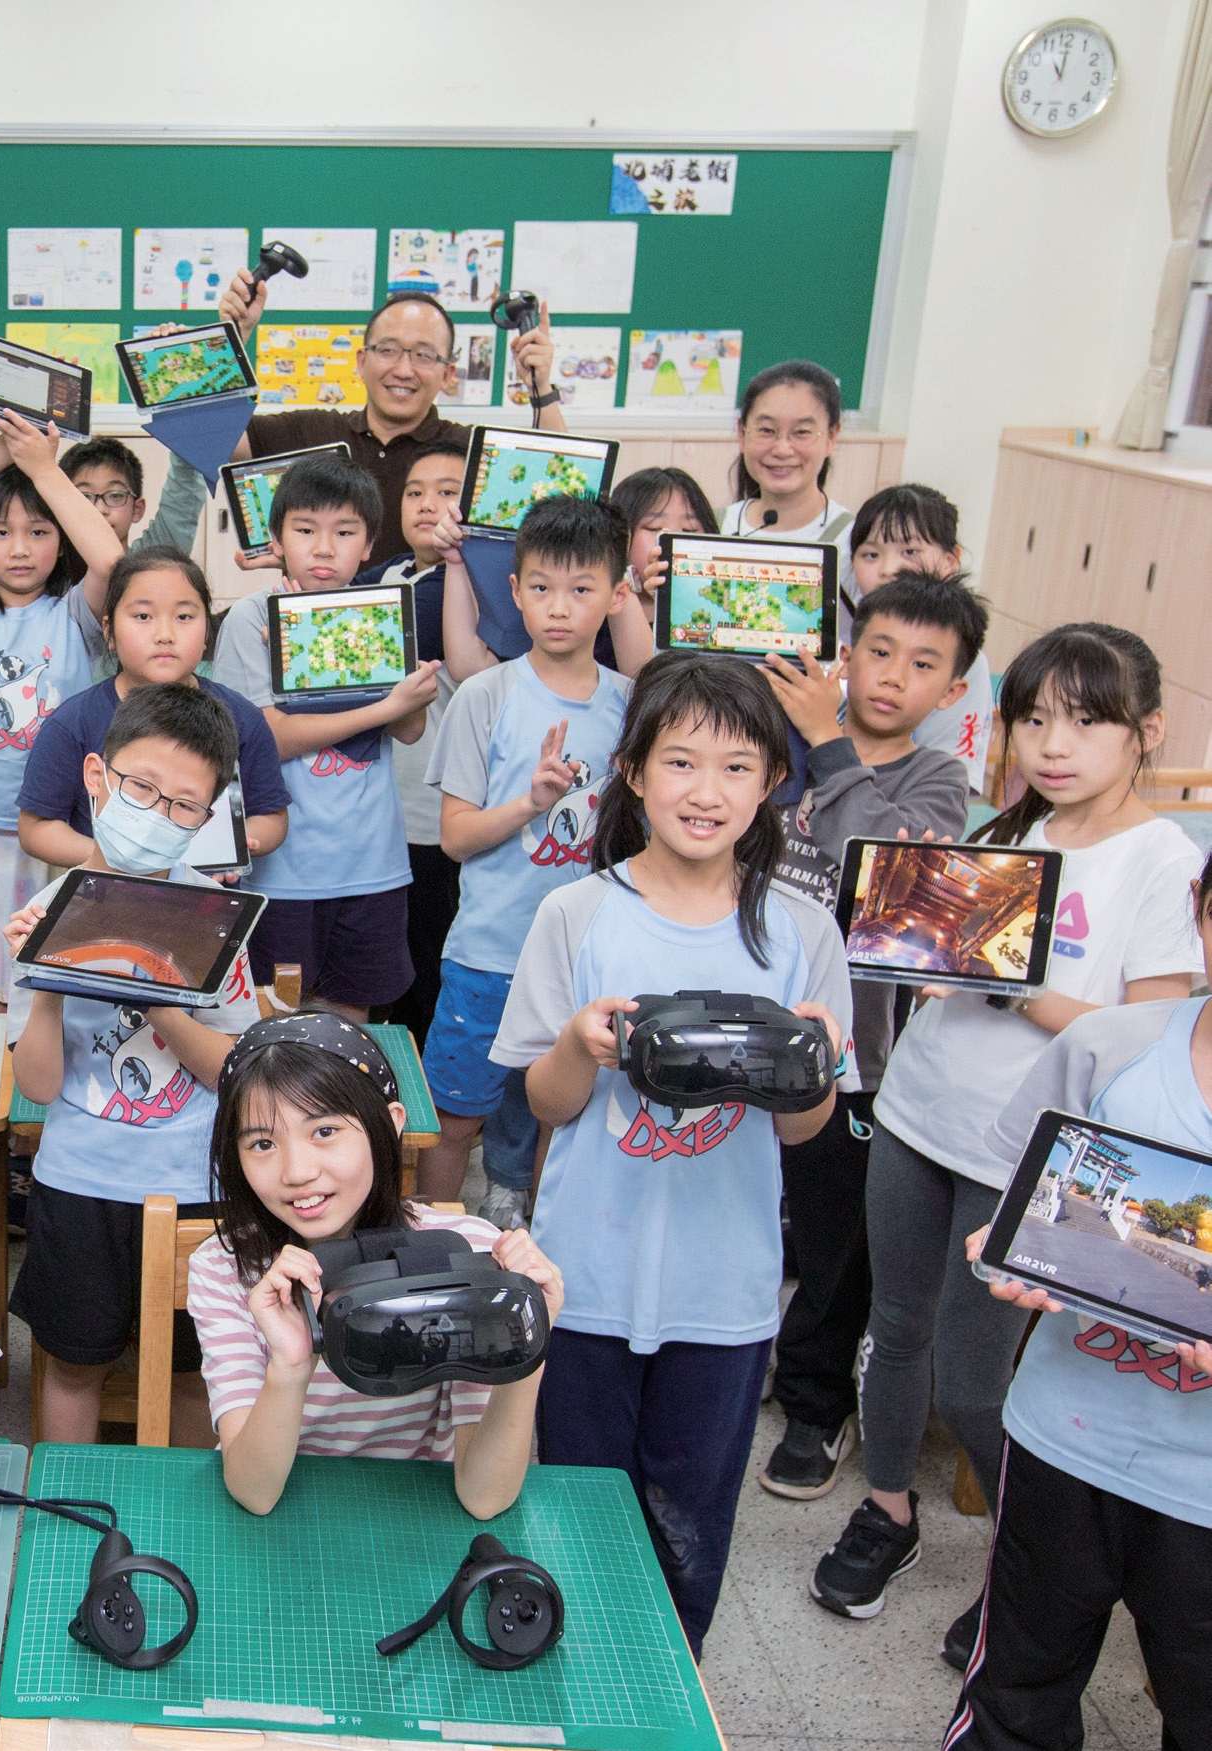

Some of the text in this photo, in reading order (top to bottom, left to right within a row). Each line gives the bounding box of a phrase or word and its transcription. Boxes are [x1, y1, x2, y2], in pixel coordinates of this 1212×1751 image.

[1059, 33, 1074, 48] 12
[39, 954, 72, 964] AR2VR
[1013, 1253, 1058, 1275] AR2VR
